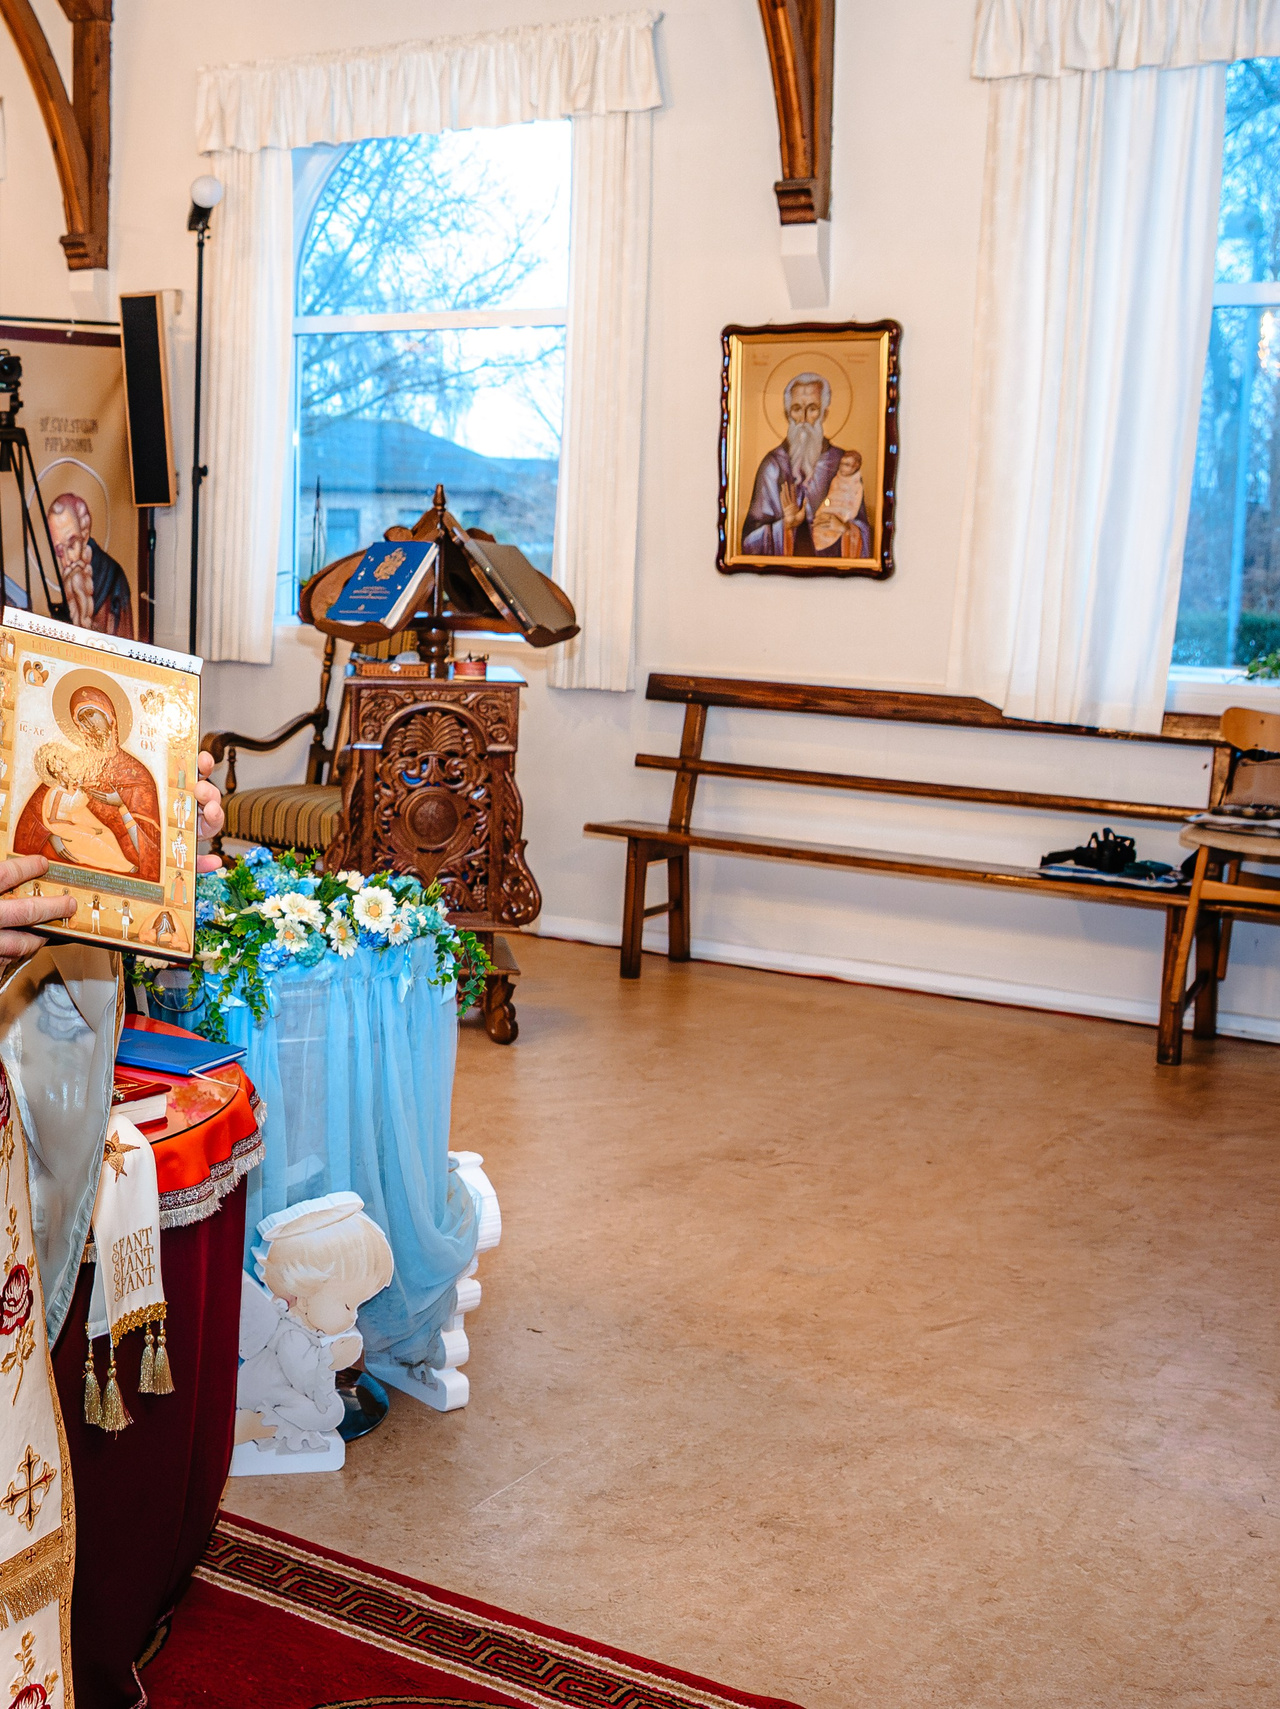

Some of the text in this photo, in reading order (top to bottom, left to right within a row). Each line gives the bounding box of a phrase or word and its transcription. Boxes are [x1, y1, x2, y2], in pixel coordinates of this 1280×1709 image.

[112, 1226, 153, 1264] SFANT
[113, 1245, 154, 1284] SFANT
[114, 1264, 155, 1302] SFANT
